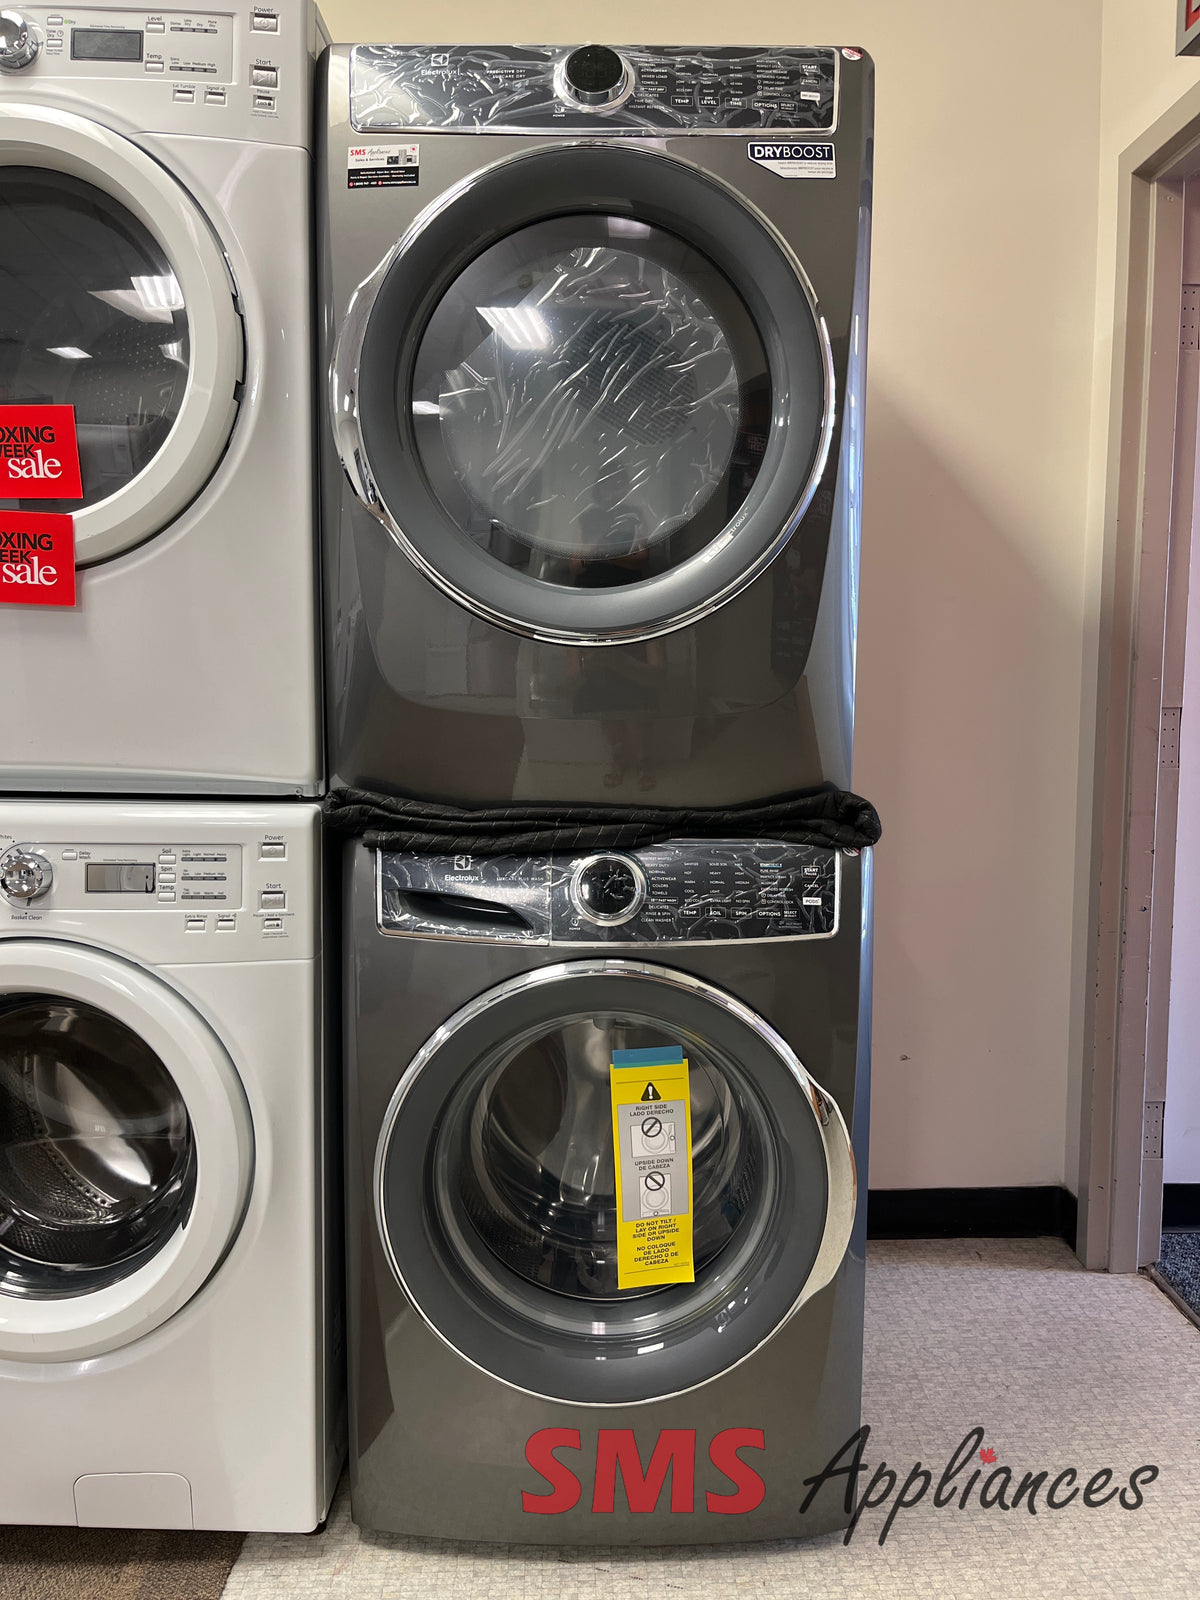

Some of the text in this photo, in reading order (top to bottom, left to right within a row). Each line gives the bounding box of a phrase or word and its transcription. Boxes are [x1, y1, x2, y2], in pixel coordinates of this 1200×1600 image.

[255, 58, 272, 66] Start
[350, 148, 367, 157] SMS
[754, 146, 830, 158] DRYBOOST
[8, 449, 62, 478] sale
[0, 532, 53, 551] XING
[2, 556, 58, 586] sale
[646, 1241, 676, 1249] COLOQUE
[634, 1254, 663, 1262] DERECHO
[644, 1258, 669, 1266] CABEZA
